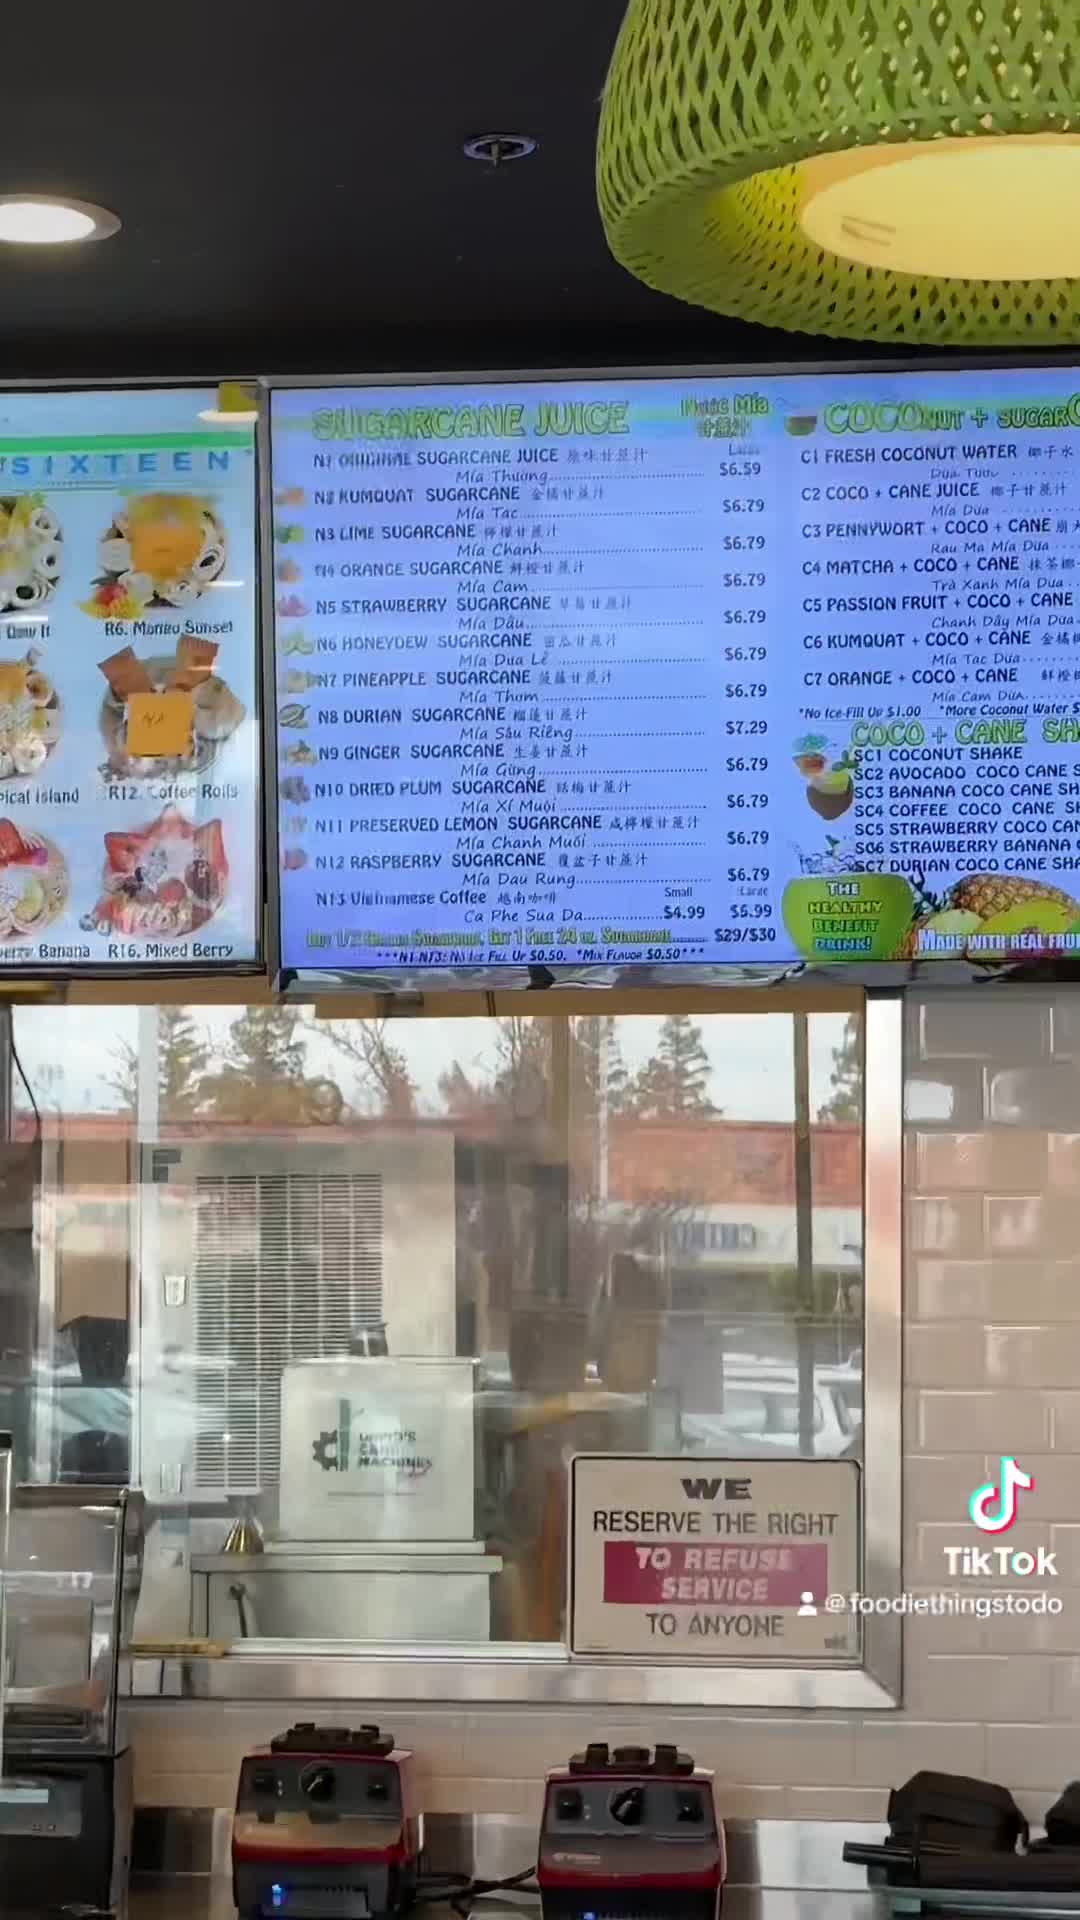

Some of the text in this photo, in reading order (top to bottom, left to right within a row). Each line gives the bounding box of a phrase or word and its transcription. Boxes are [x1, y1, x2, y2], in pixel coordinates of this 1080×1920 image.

[313, 401, 630, 440] SUGARCANE JUICE
[417, 450, 512, 465] SUGARCANE
[517, 448, 558, 463] JUICE
[825, 445, 1017, 462] FRESH COCONUT WATER
[11, 451, 230, 475] SIXTEEN
[719, 462, 760, 476] $6.59
[339, 488, 414, 504] KUMQUAT
[426, 487, 520, 501] SUGARCANE
[801, 483, 979, 501] C2 COCO CANE JUICE
[723, 499, 764, 513] $6.79
[340, 525, 476, 540] LIME SUGARCANE
[802, 524, 821, 538] C3
[826, 521, 925, 537] PENNYWORT
[945, 520, 988, 534] COCO
[1008, 519, 1051, 532] CANE
[492, 542, 543, 556] Chanh
[724, 536, 765, 550] $6.79
[341, 560, 503, 577] ORANGE SUGARCANE
[802, 561, 820, 575] C4
[826, 560, 894, 574] MATCHA
[914, 558, 957, 572] COCO
[977, 557, 1019, 570] CANE
[493, 580, 528, 593] Cam
[723, 573, 766, 587] $6.79
[962, 579, 1000, 590] Xanh
[316, 596, 551, 615] N5 STRAWBERRY SUGARCANE
[803, 593, 1073, 612] C5 PASSION FRUIT COCO CANE
[724, 610, 766, 624] $6.79
[931, 616, 976, 629] Chanh
[185, 620, 233, 635] Sunset
[342, 636, 428, 650] HONEYDEW
[438, 633, 532, 649] SUGARCANE
[803, 635, 823, 649] C6
[828, 633, 905, 648] KUMQUAT
[925, 632, 969, 646] COCO
[989, 631, 1031, 645] CANE
[725, 647, 766, 661] $6.79
[343, 670, 530, 686] PINEAPPLE SUGARCANE
[804, 668, 1018, 686] C7 ORANGE COCO CANE
[725, 684, 767, 698] $6.79
[319, 707, 505, 724] N8 DURIAN SUGARCANE
[887, 706, 921, 717] $1.00
[980, 702, 1069, 715] Coconut Water
[726, 721, 767, 735] $7.29
[851, 719, 924, 747] COCO
[955, 718, 1027, 745] CANE
[319, 744, 504, 760] N9 GINGER SUGARCANE
[854, 746, 1022, 763] SC1 COCONUT SHAKE
[726, 757, 767, 771] $6.79
[854, 764, 1067, 780] SC2 AVOCADO COCO CANE
[35, 788, 79, 804] Island
[315, 780, 546, 796] N10 DRIED PLUM SUGARCANE
[854, 786, 884, 799] SC3
[889, 784, 955, 798] BANANA
[962, 783, 1004, 797] COCO
[1010, 783, 1052, 796] CANE
[727, 794, 768, 808] $6.79
[855, 804, 884, 817] SC4
[889, 803, 947, 817] COFFEE
[959, 802, 1001, 816] COCO
[1012, 801, 1054, 814] CANE
[315, 816, 602, 833] N11 PRESERVED LEMON SUGARCANE
[855, 820, 1046, 836] SC5 STRAWBERRY COCO
[492, 836, 542, 850] Chanh
[727, 831, 769, 845] $6.79
[855, 839, 1071, 855] SC6 STRAWBERRY BANANA
[316, 852, 546, 870] N12 RASPBERRY SUGARCANE
[857, 857, 1047, 873] SC7 DURIAN COCO CANE
[728, 868, 770, 882] $6.79
[439, 891, 487, 904] Coffee
[664, 887, 693, 897] Small
[491, 909, 519, 922] Phe
[663, 905, 705, 919] $4.99
[808, 901, 883, 914] HEALTHY
[812, 918, 880, 932] BENEFIT
[714, 928, 776, 942] $29/$30
[39, 945, 91, 958] Banana
[108, 943, 233, 958] R16. Mixed Berry
[681, 1478, 753, 1500] WE
[593, 1510, 839, 1536] RESERVE THE RIGHT
[636, 1546, 793, 1571] TO REFUSE
[660, 1577, 769, 1600] SERVICE
[646, 1613, 785, 1637] TO ANYONE
